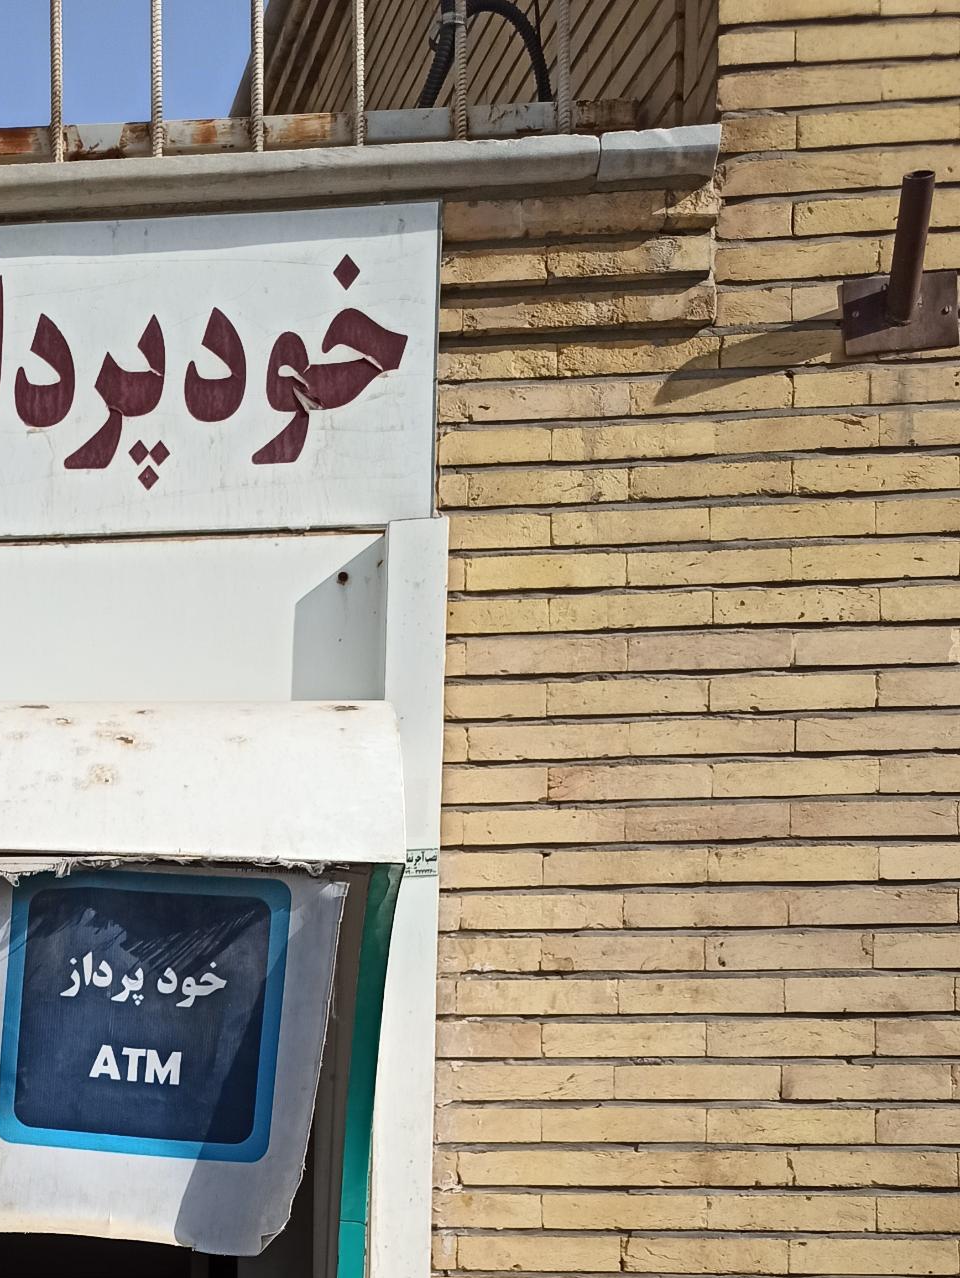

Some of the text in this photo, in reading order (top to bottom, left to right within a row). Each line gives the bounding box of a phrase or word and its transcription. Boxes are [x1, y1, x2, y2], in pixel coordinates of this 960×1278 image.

[60, 952, 227, 1007] خود پرداز
[89, 1044, 182, 1085] ATM
